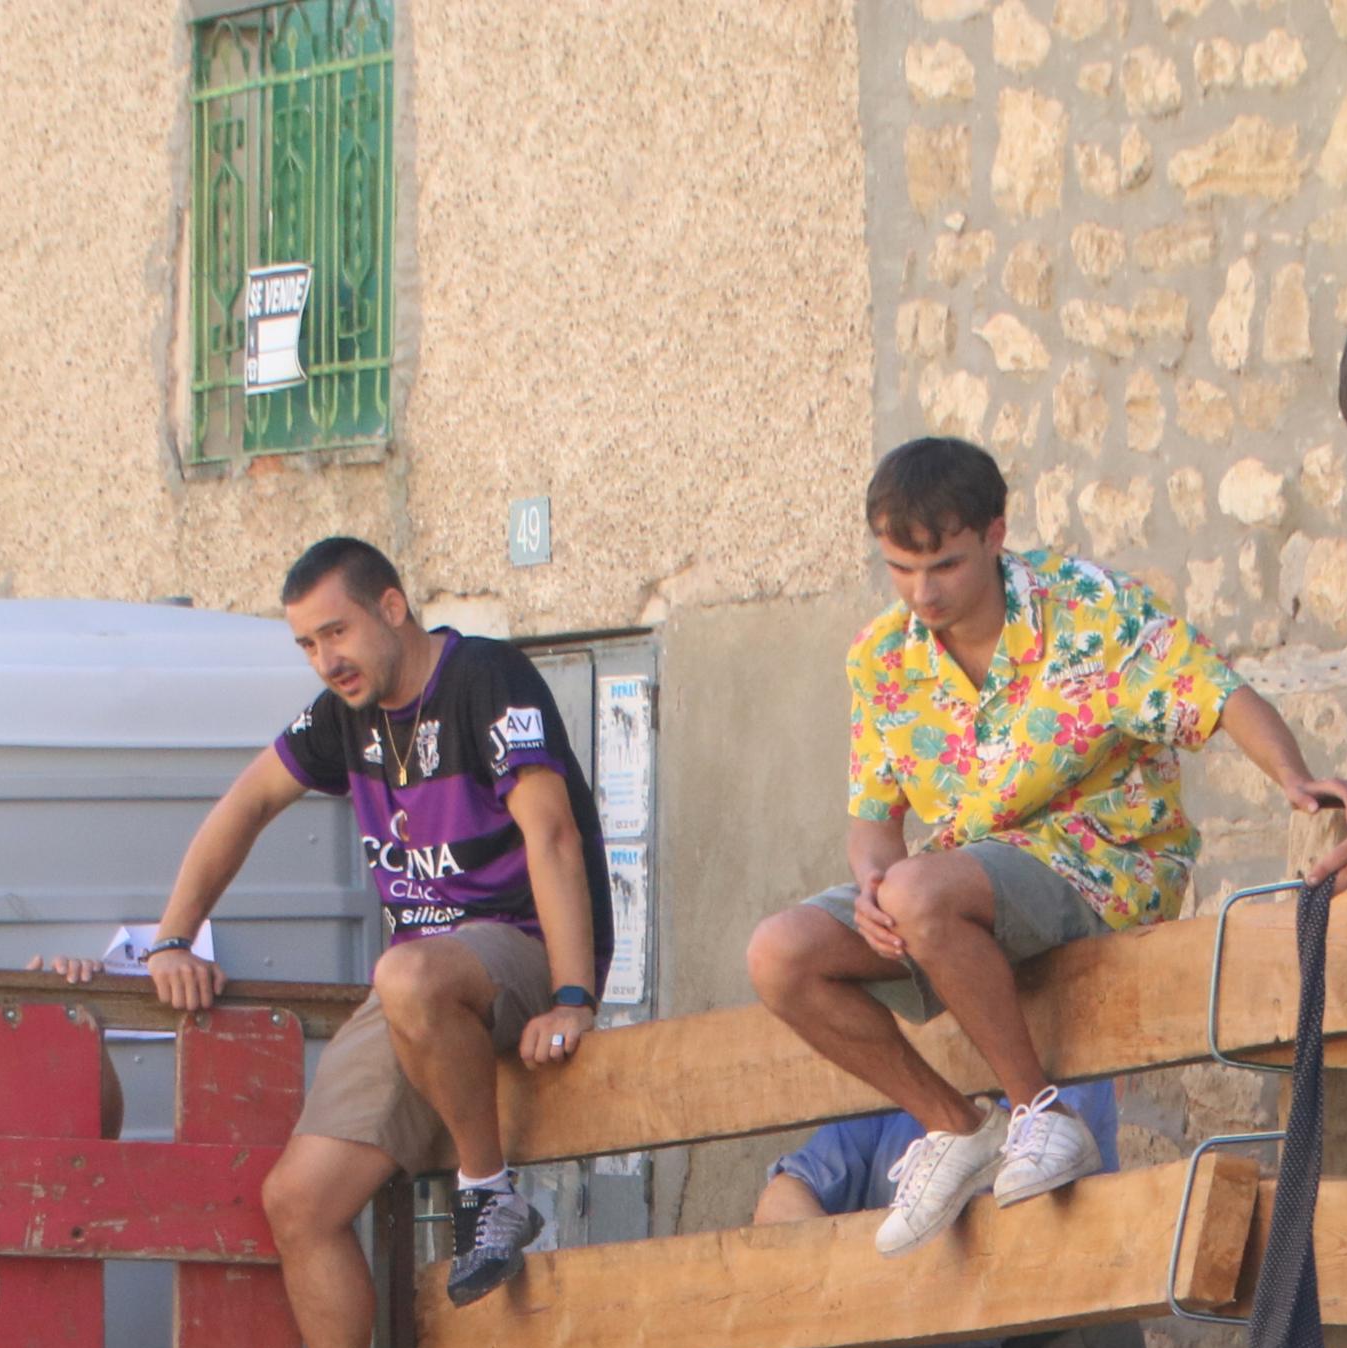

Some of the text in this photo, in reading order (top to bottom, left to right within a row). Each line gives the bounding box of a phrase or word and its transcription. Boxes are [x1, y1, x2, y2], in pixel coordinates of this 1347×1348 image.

[248, 273, 307, 318] SE VENDE
[516, 505, 541, 554] 49
